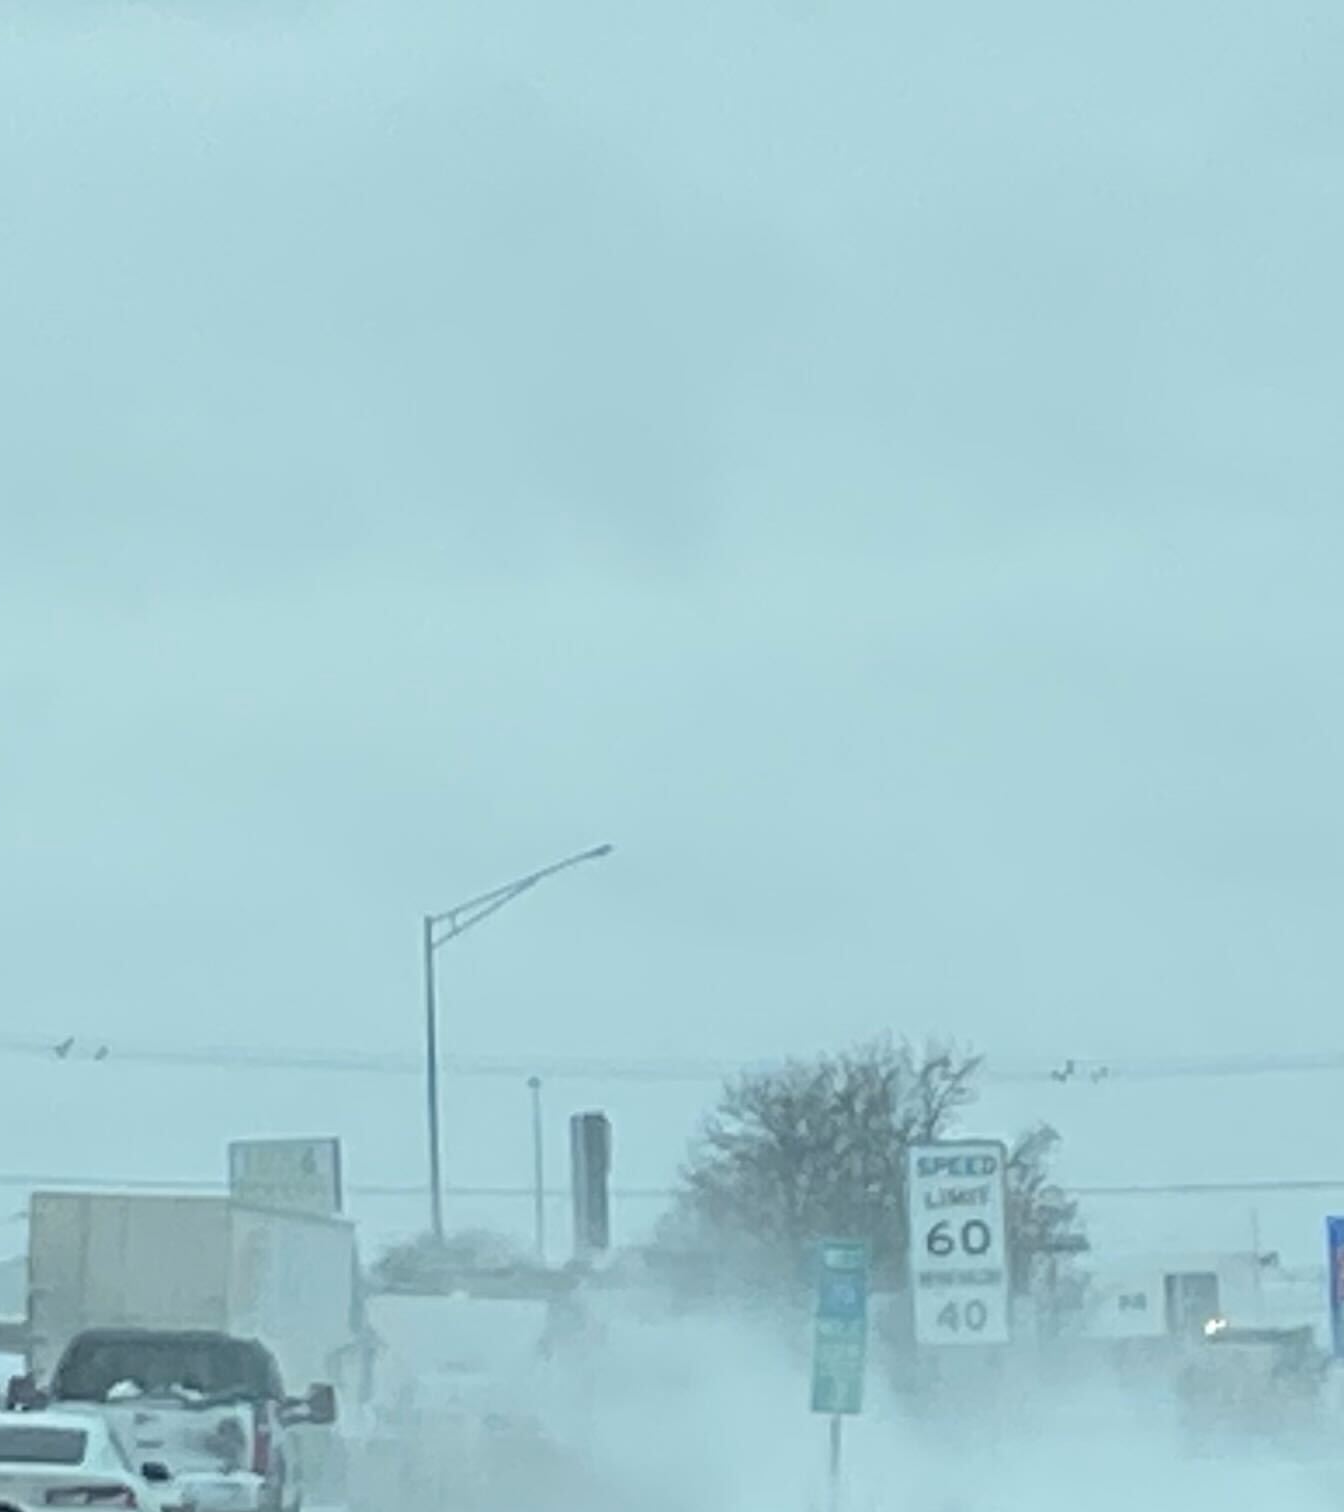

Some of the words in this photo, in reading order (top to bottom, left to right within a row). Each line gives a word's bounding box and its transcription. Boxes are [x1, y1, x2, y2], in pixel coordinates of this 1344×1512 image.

[916, 1155, 997, 1178] SPEED
[924, 1184, 990, 1209] LIMIT
[926, 1219, 991, 1256] 60
[936, 1298, 988, 1332] 40
